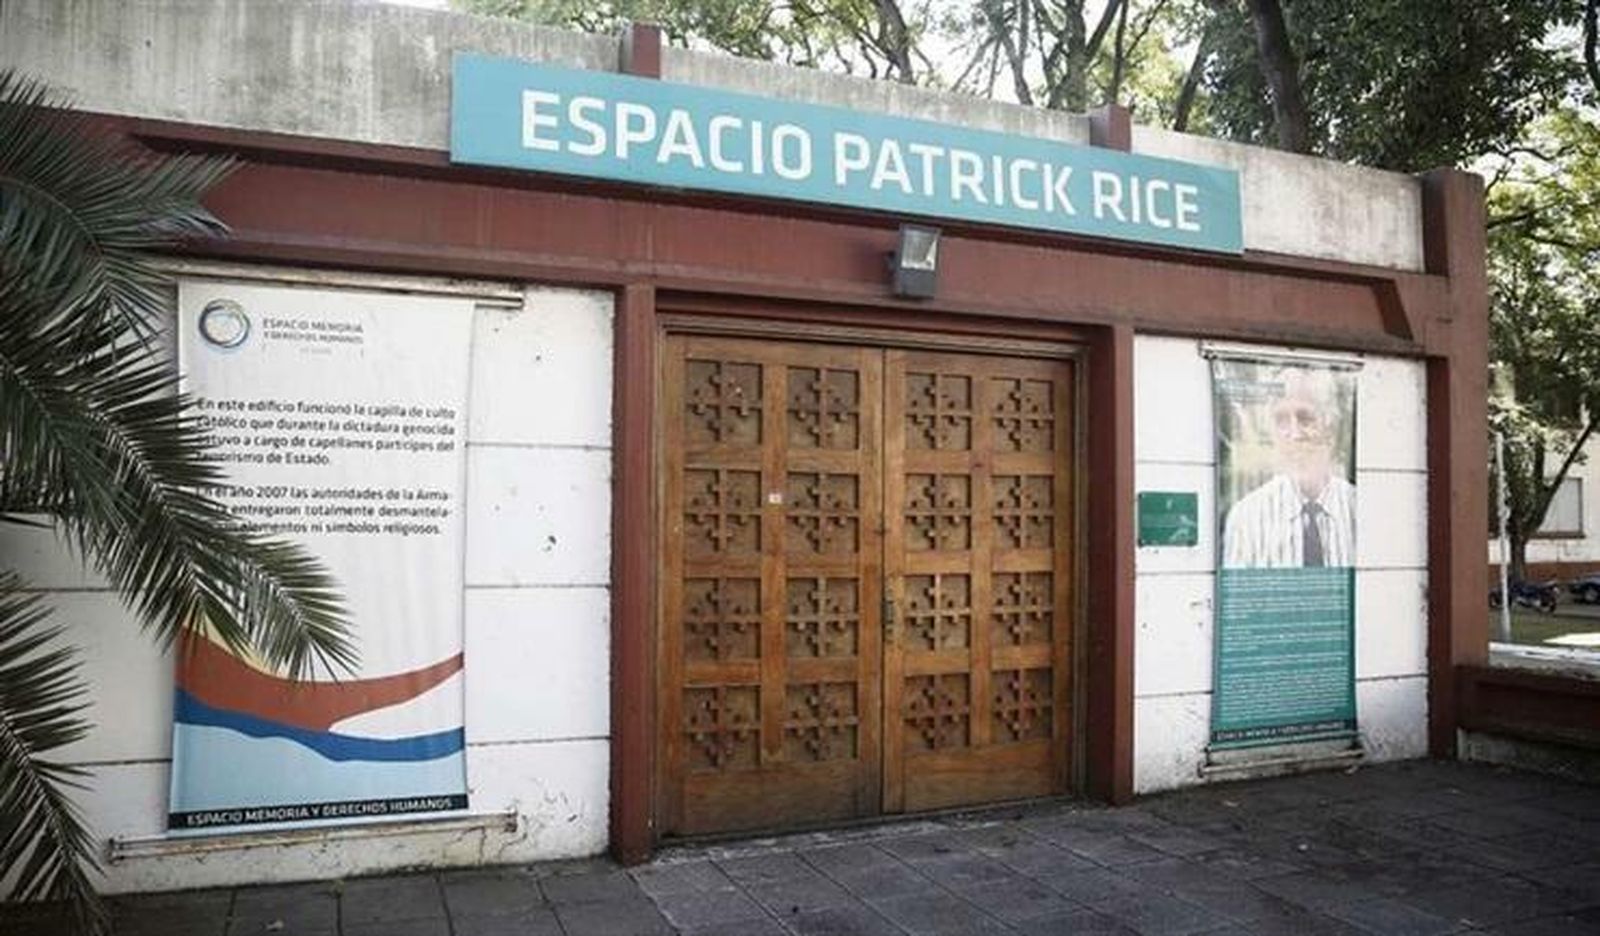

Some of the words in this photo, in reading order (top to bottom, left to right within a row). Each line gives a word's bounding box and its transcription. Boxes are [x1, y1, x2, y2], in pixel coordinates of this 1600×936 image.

[520, 88, 812, 179] ESPACIO
[835, 132, 1076, 216] PATRICK
[1093, 170, 1200, 232] RICE
[262, 318, 309, 331] ESPACIO
[311, 320, 364, 333] MEMORIA
[197, 398, 215, 410] En
[218, 400, 245, 411] este
[248, 399, 295, 412] edificio
[297, 400, 352, 414] funcionó
[354, 403, 365, 415] la
[367, 404, 406, 419] capilla
[408, 405, 423, 417] de
[425, 406, 455, 419] culto
[249, 419, 274, 432] que
[277, 418, 326, 431] durante
[328, 419, 340, 431] la
[342, 419, 400, 433] dictadura
[402, 422, 455, 436] genocida
[243, 437, 251, 446] a
[254, 436, 289, 449] cargo
[290, 436, 306, 447] de
[309, 437, 374, 450] capellanes
[376, 439, 434, 453] partícipes
[436, 440, 455, 452] del
[266, 452, 282, 464] de
[229, 486, 254, 498] año
[256, 486, 288, 498] 2007
[290, 486, 308, 499] las
[311, 487, 383, 500] autoridades
[385, 487, 401, 500] de
[402, 488, 414, 500] la
[231, 504, 302, 518] entregaron
[304, 504, 374, 517] totalmente
[241, 520, 307, 533] elementos
[310, 522, 323, 533] ni
[325, 522, 380, 534] símbolos
[187, 811, 243, 826] ESPACIO
[245, 807, 309, 822] MEMORIA
[311, 806, 320, 817] Y
[322, 801, 388, 816] DERECHOS
[390, 797, 452, 812] HUMANOS
